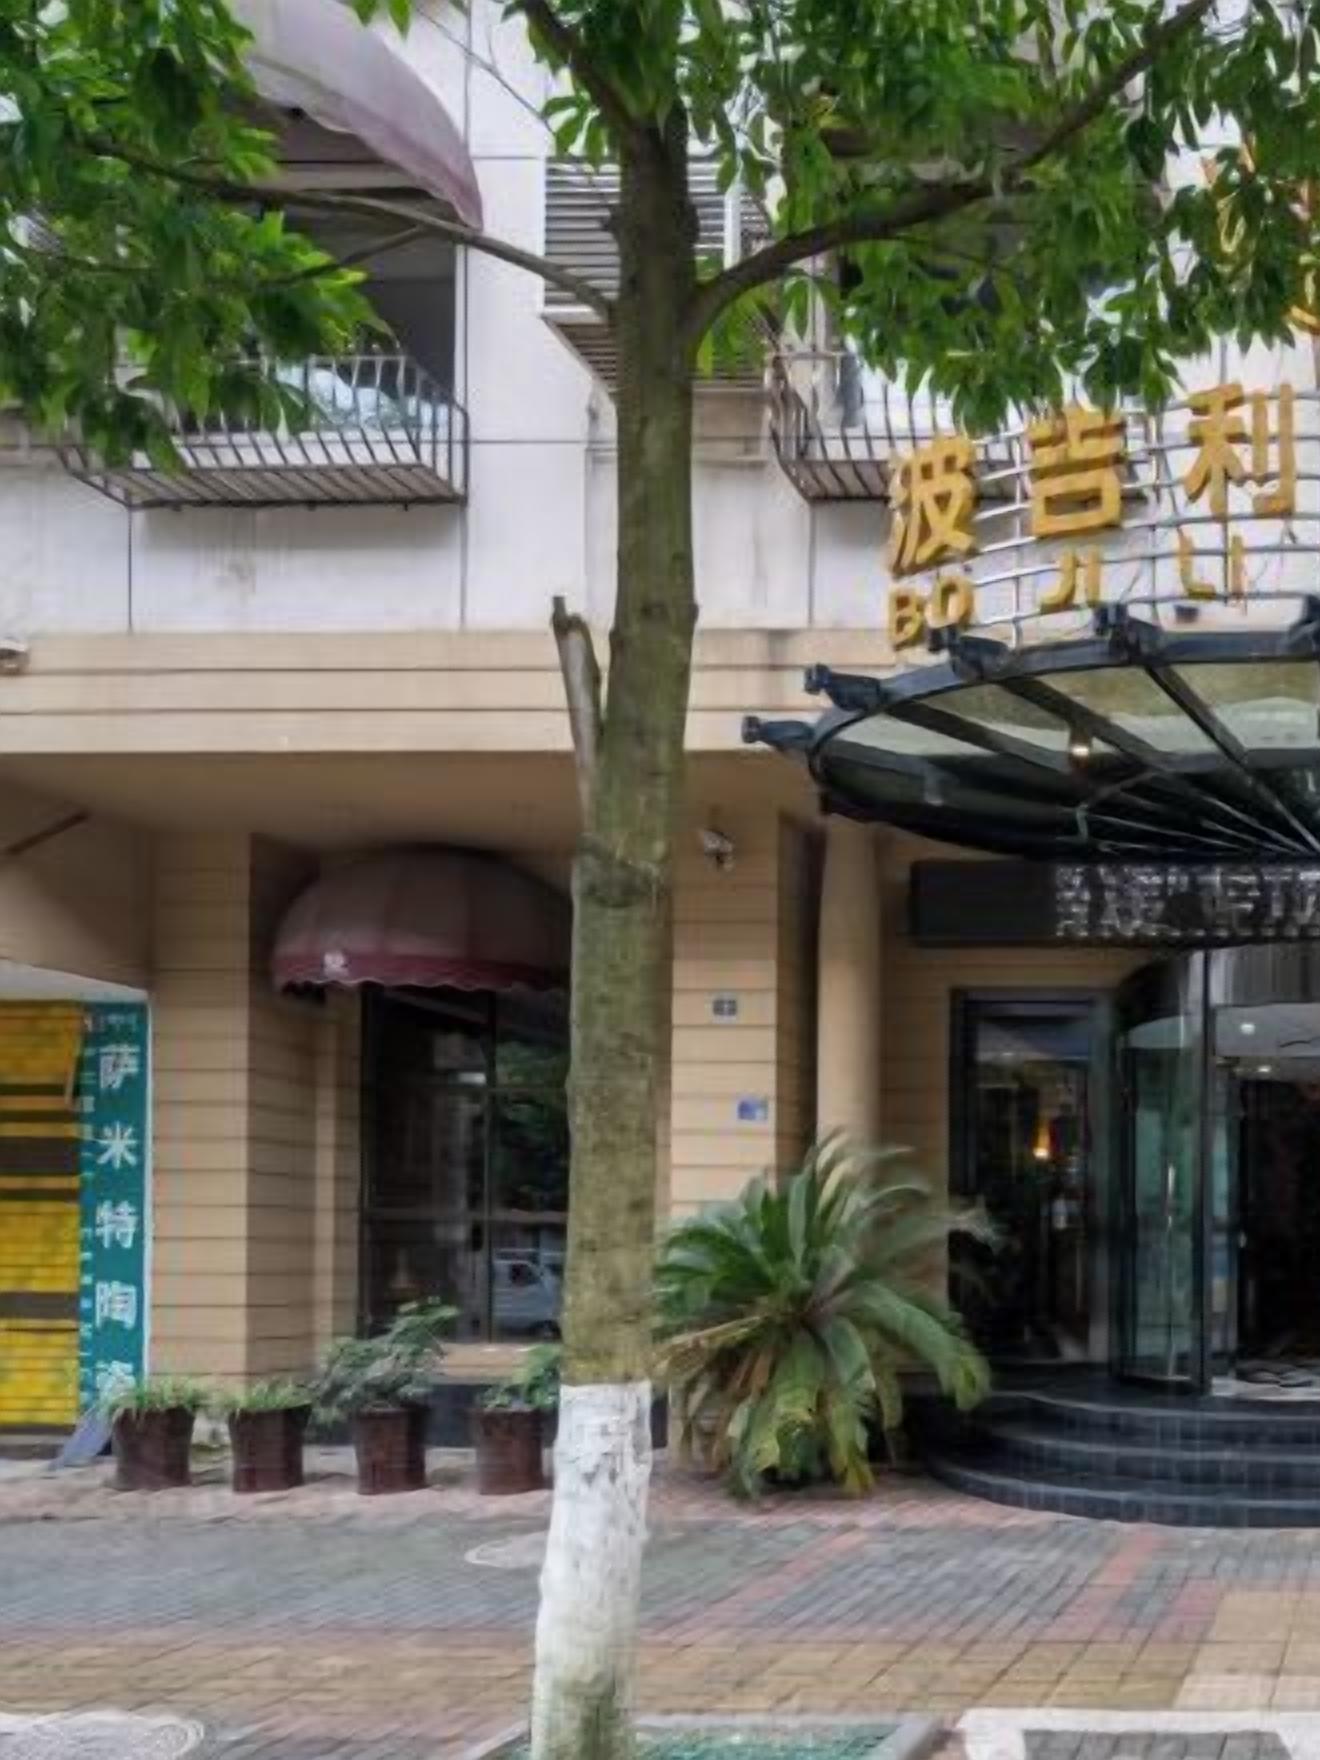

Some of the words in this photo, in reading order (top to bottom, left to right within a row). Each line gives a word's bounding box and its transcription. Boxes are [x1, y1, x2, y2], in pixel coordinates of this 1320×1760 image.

[890, 575, 974, 650] BO
[1040, 549, 1100, 611] JI
[1177, 526, 1245, 600] LI
